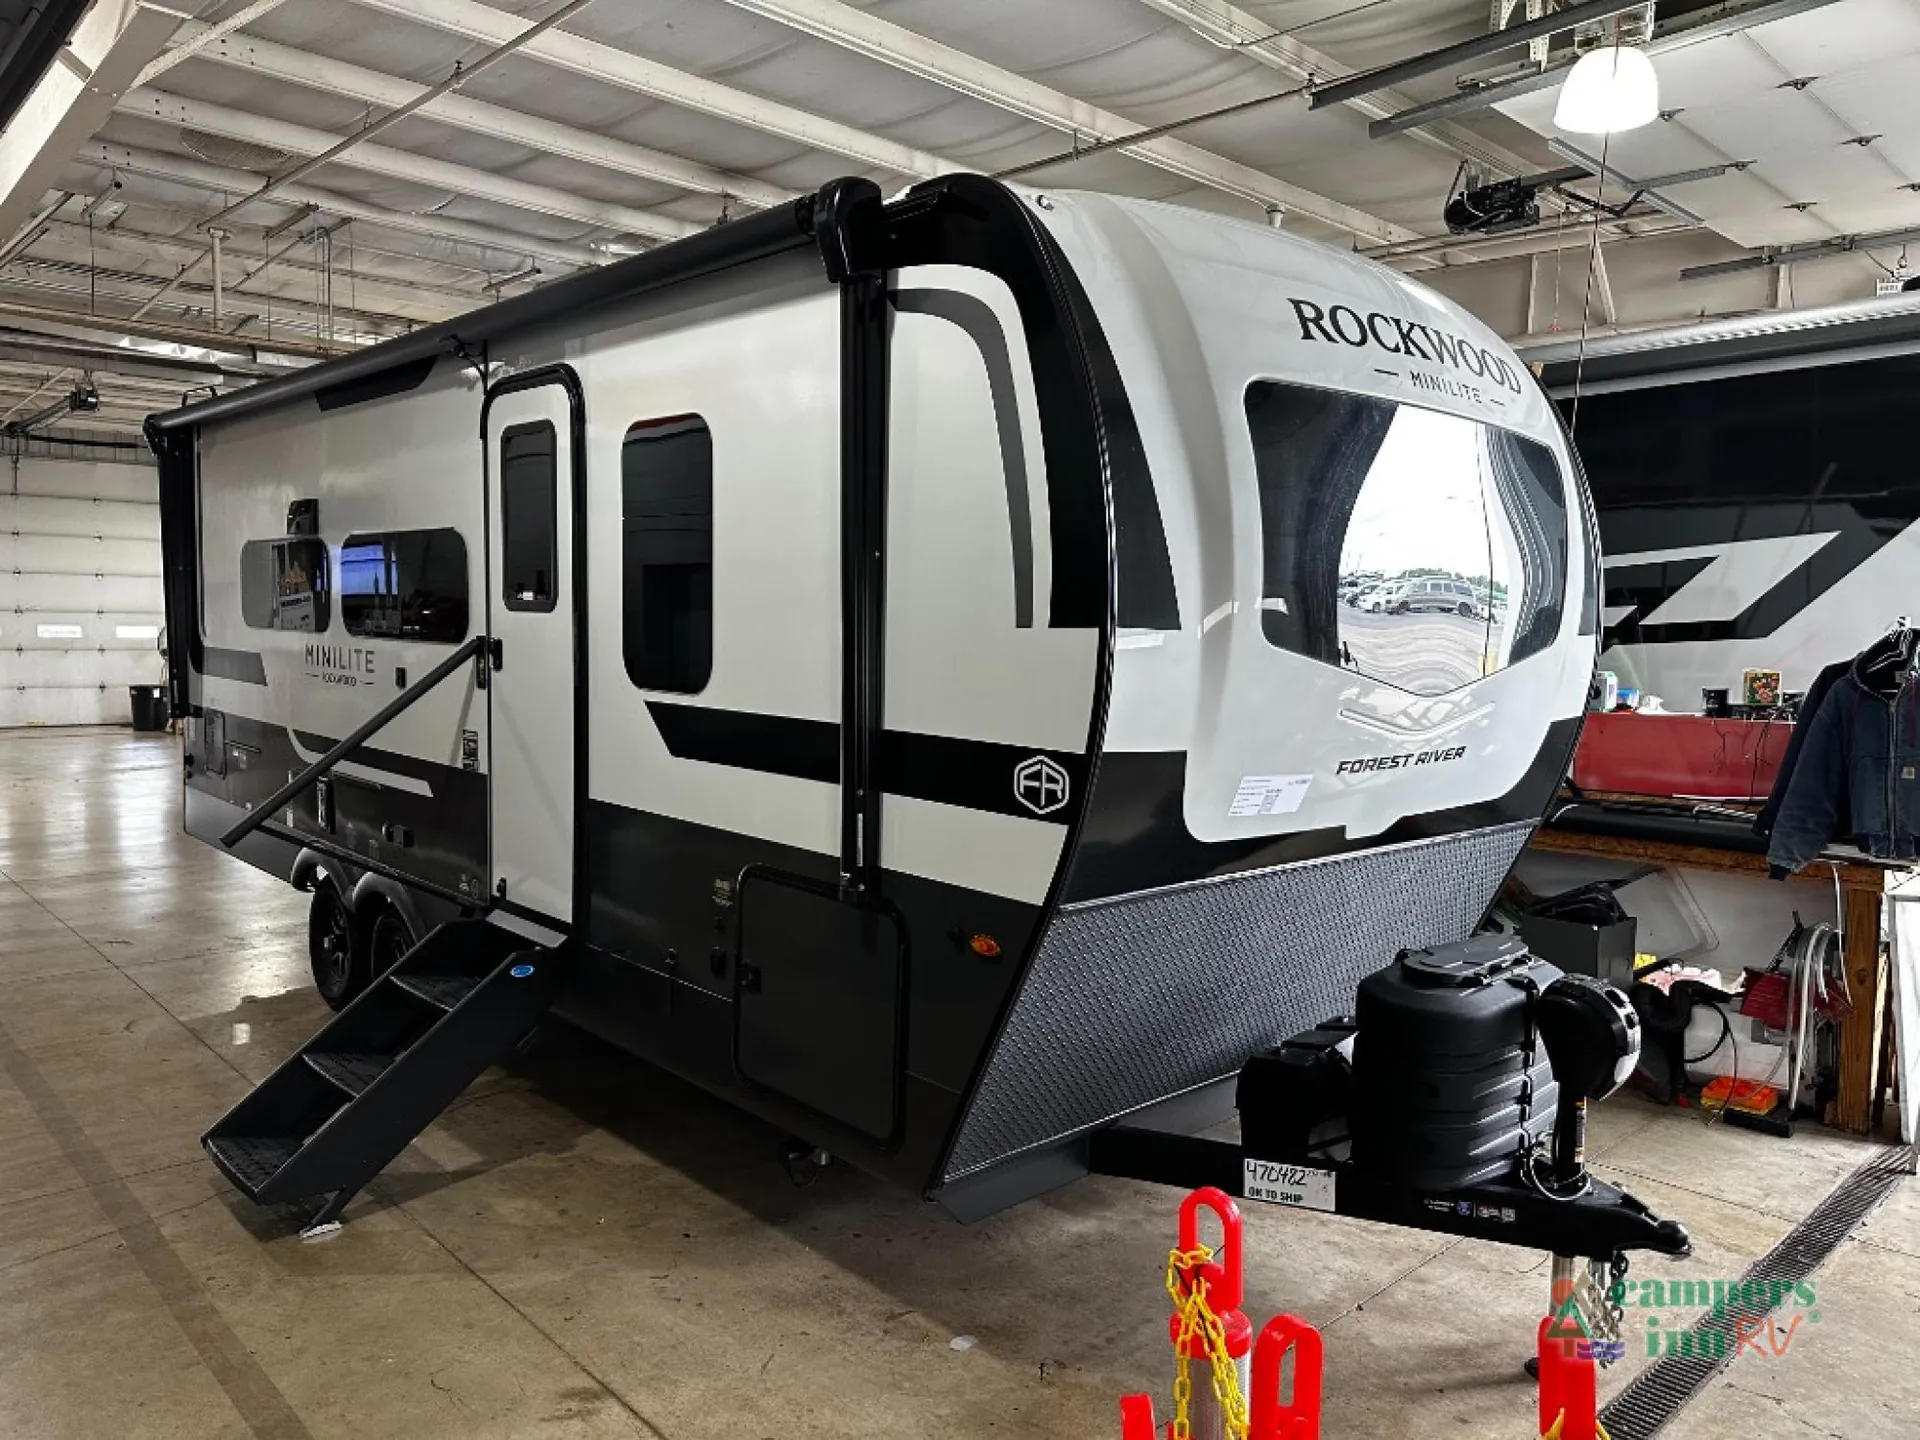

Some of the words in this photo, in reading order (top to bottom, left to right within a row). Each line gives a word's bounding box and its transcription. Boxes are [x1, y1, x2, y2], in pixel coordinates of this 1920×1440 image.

[1287, 297, 1521, 394] ROCKWOOD
[1409, 369, 1484, 404] MINILITE
[304, 643, 376, 674] MINILITE
[1336, 753, 1415, 775] FOREST
[1414, 745, 1467, 766] RIVER
[1248, 1186, 1263, 1198] OK
[1265, 1188, 1278, 1200] TO
[1280, 1191, 1304, 1204] SHIP
